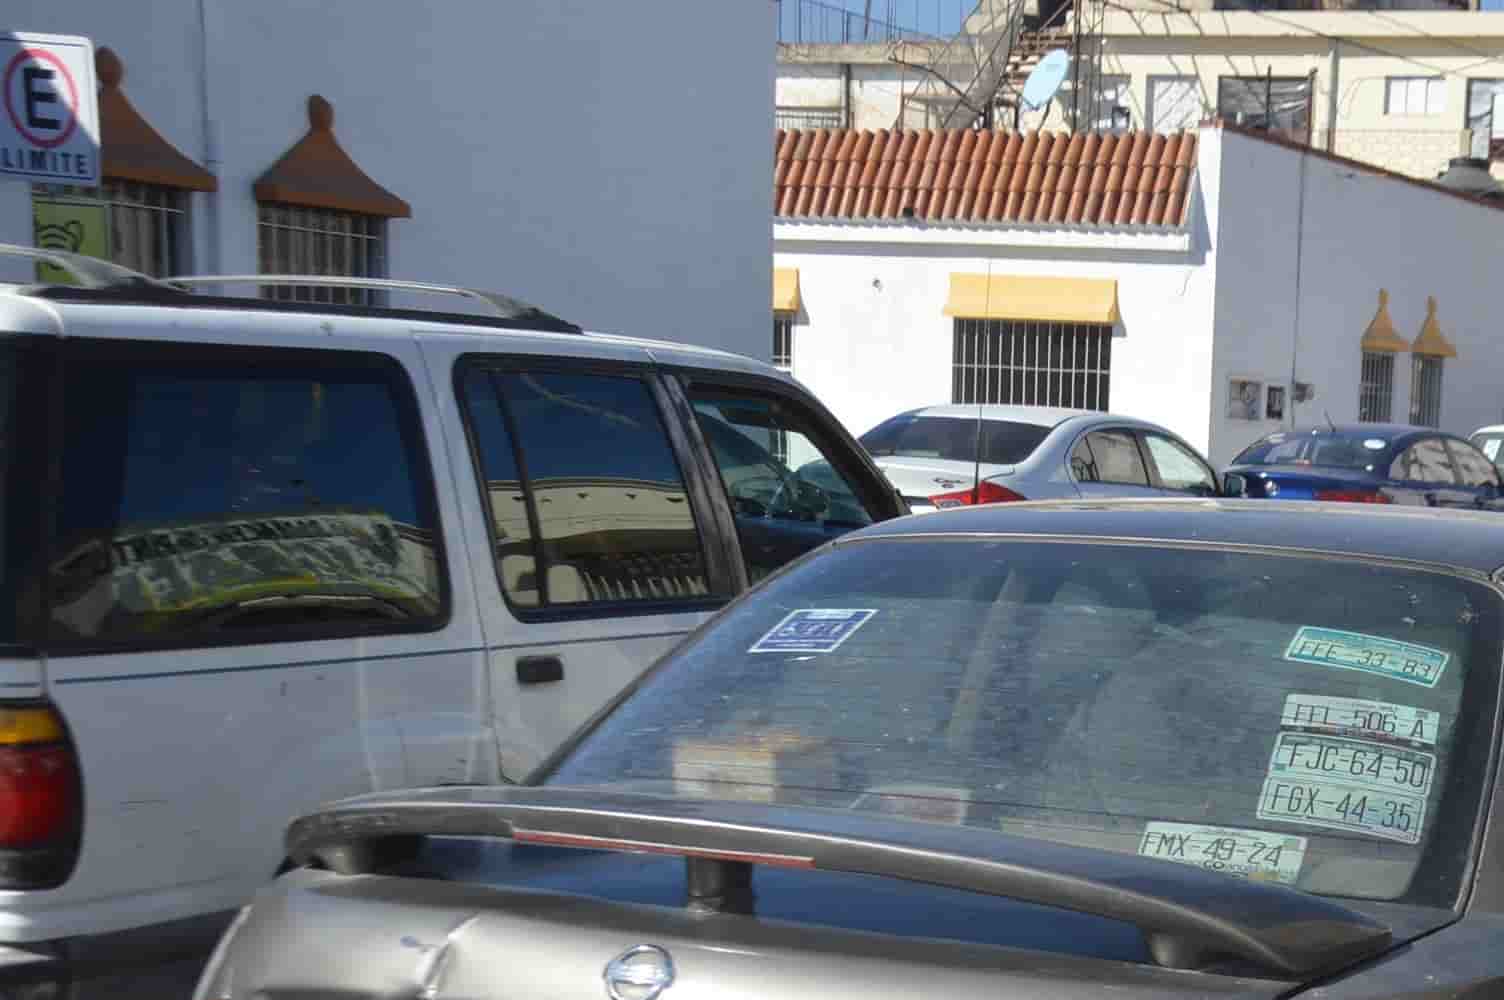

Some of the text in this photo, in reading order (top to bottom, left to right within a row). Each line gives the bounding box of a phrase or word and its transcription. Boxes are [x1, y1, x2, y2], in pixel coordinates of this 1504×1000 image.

[23, 66, 62, 130] E
[1, 148, 89, 174] LIMITE
[1288, 744, 1428, 788] FJC-64-50
[1270, 783, 1411, 832] FGX-44-35
[1141, 832, 1283, 867] FMX-49-24
